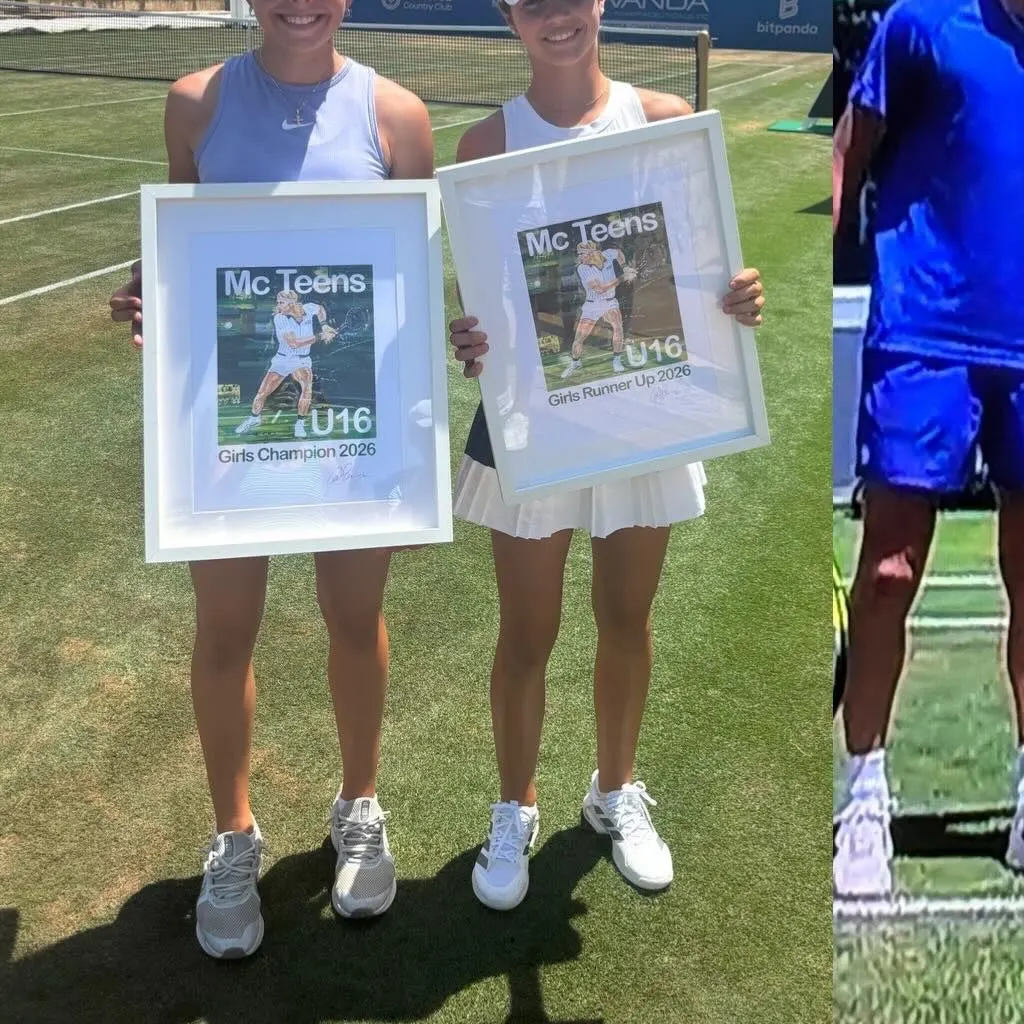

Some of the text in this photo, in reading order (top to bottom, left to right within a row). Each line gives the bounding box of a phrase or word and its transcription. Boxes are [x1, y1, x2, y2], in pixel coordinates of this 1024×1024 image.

[403, 1, 453, 12] Country Club
[756, 22, 819, 36] bitpanda
[525, 212, 659, 257] Mc Teens
[224, 268, 367, 296] Mc Teens
[626, 334, 683, 368] U16
[548, 390, 581, 407] Girls
[582, 379, 633, 400] Runner
[634, 373, 656, 389] Up
[658, 364, 692, 383] 2026
[311, 407, 373, 436] U16
[218, 442, 377, 464] Girls Champion 2026
